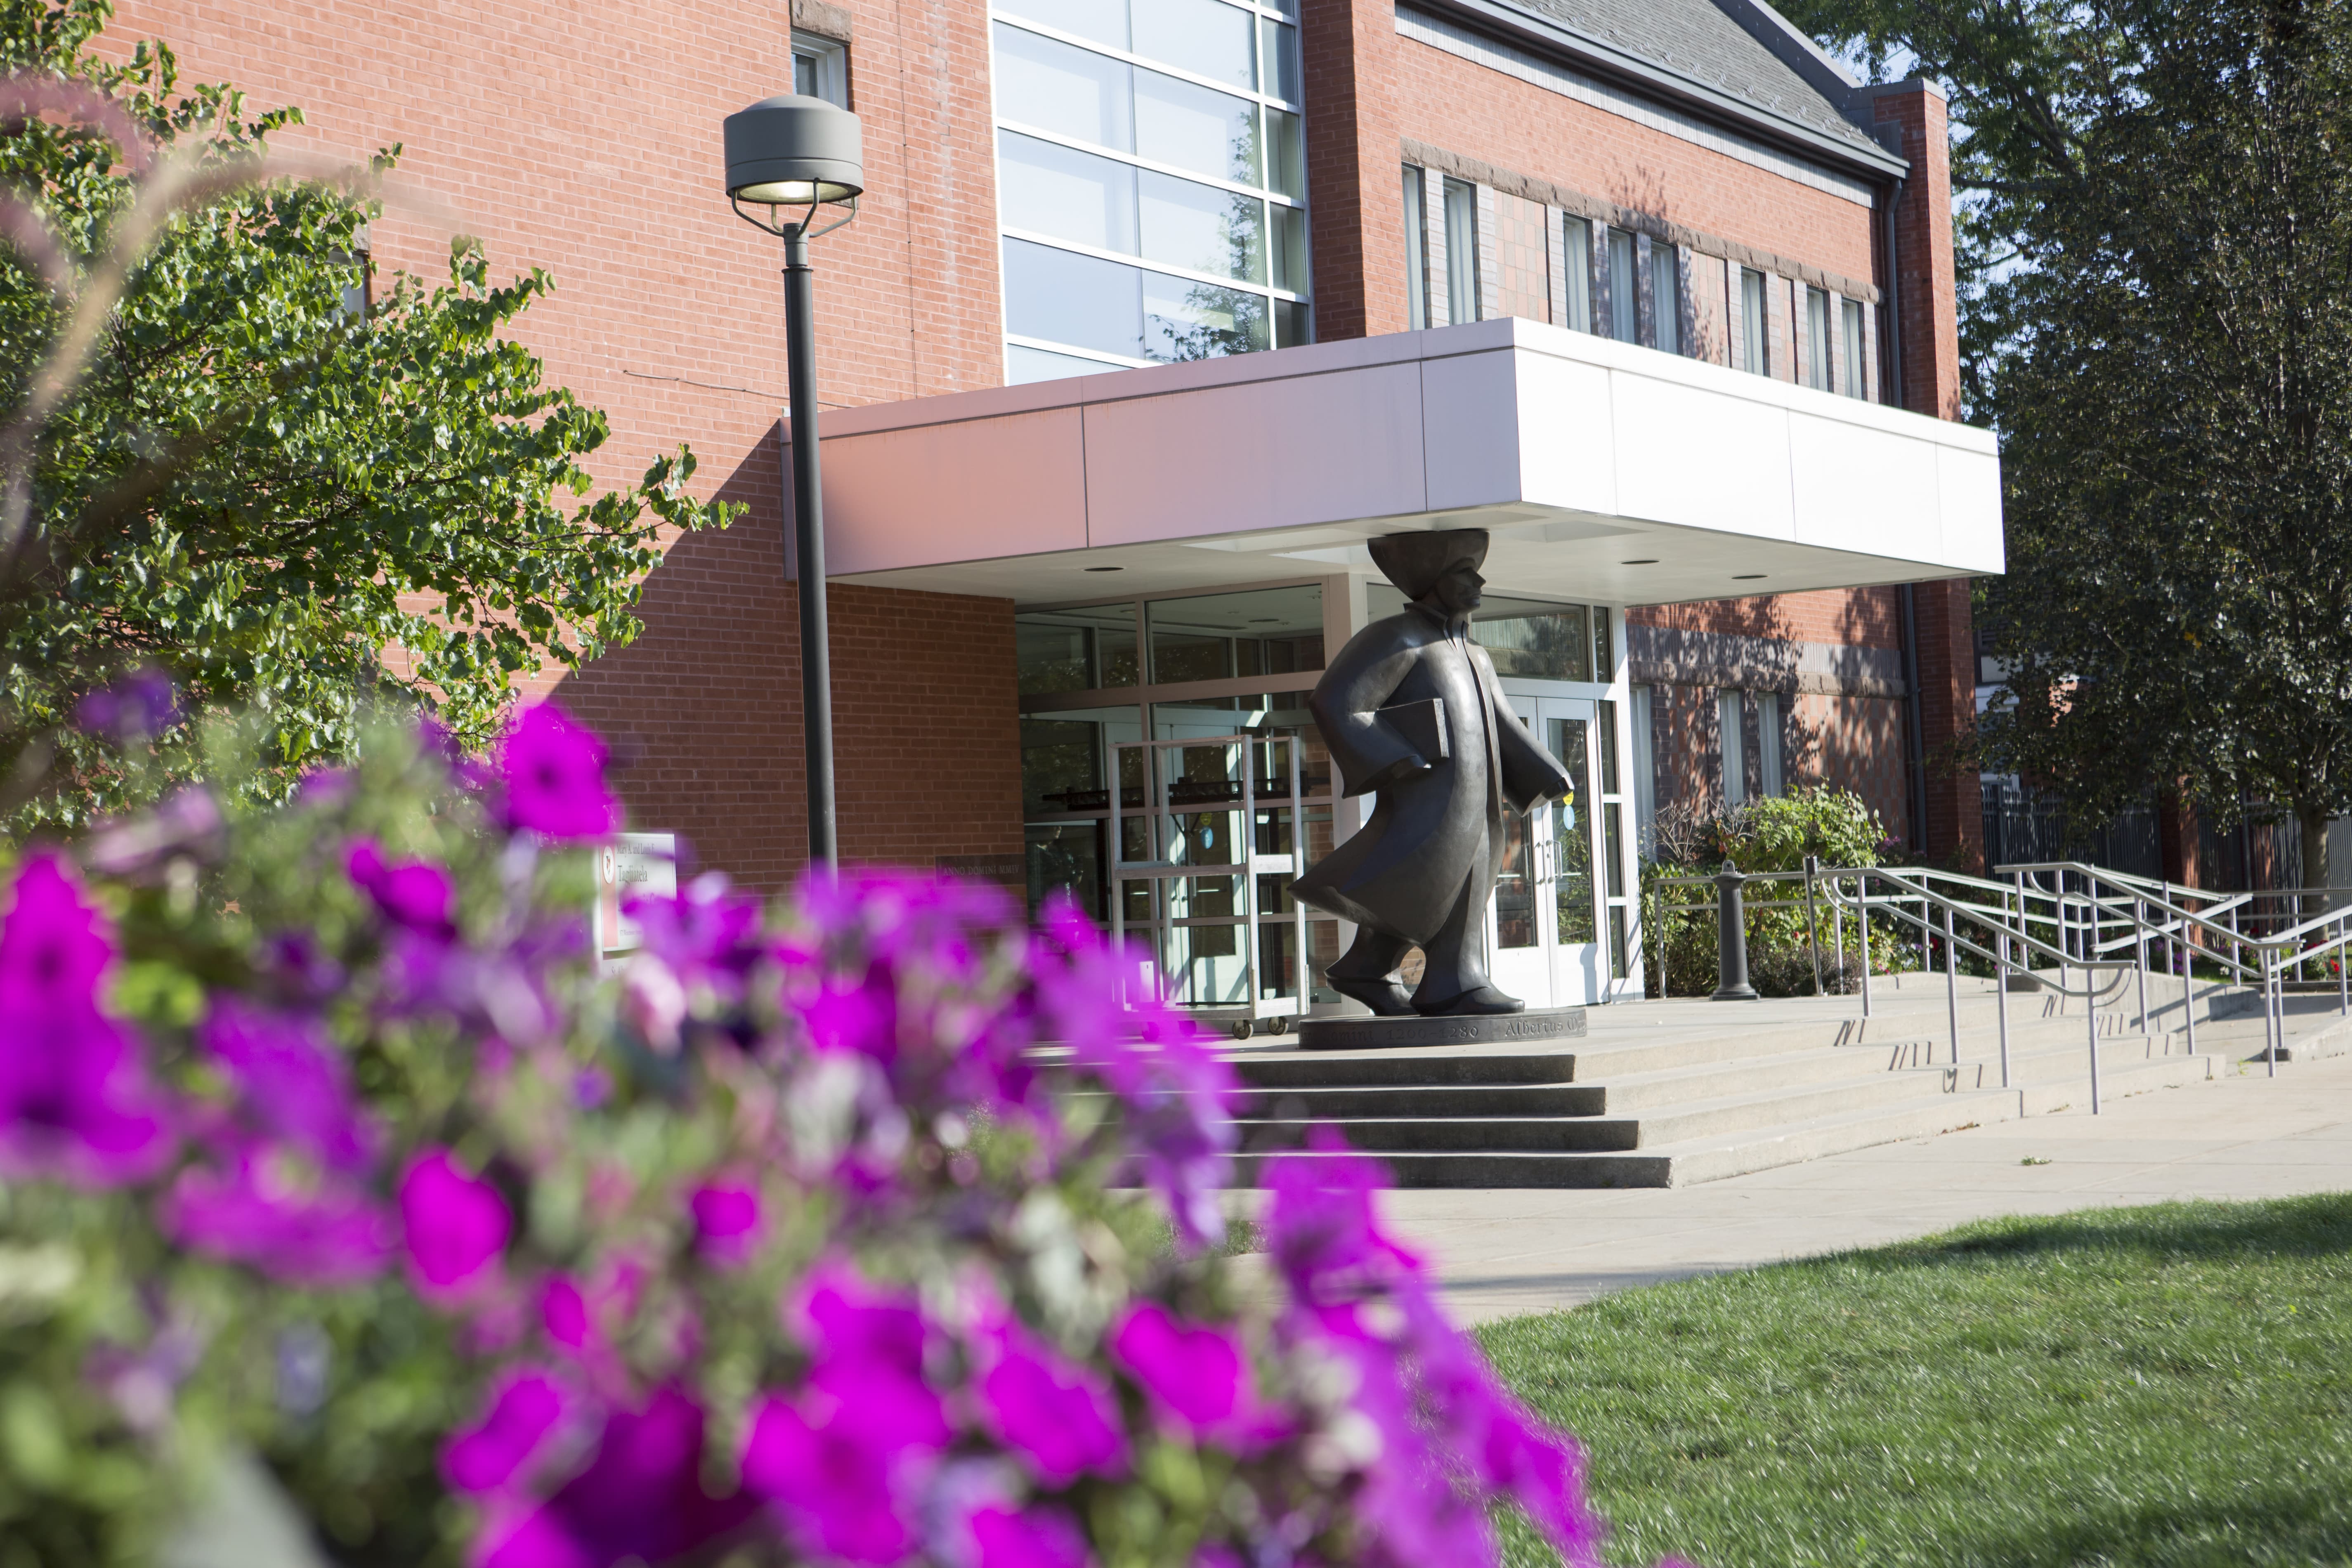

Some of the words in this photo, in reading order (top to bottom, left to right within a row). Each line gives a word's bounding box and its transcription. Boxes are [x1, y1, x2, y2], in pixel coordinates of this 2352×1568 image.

[617, 843, 627, 858] Mary
[640, 843, 651, 855] Louis
[618, 865, 648, 888] Tagliatela
[944, 867, 965, 876] ANNO
[969, 866, 996, 875] DOMINI
[999, 865, 1020, 874] MMIV
[1504, 1020, 1563, 1037] Albertus
